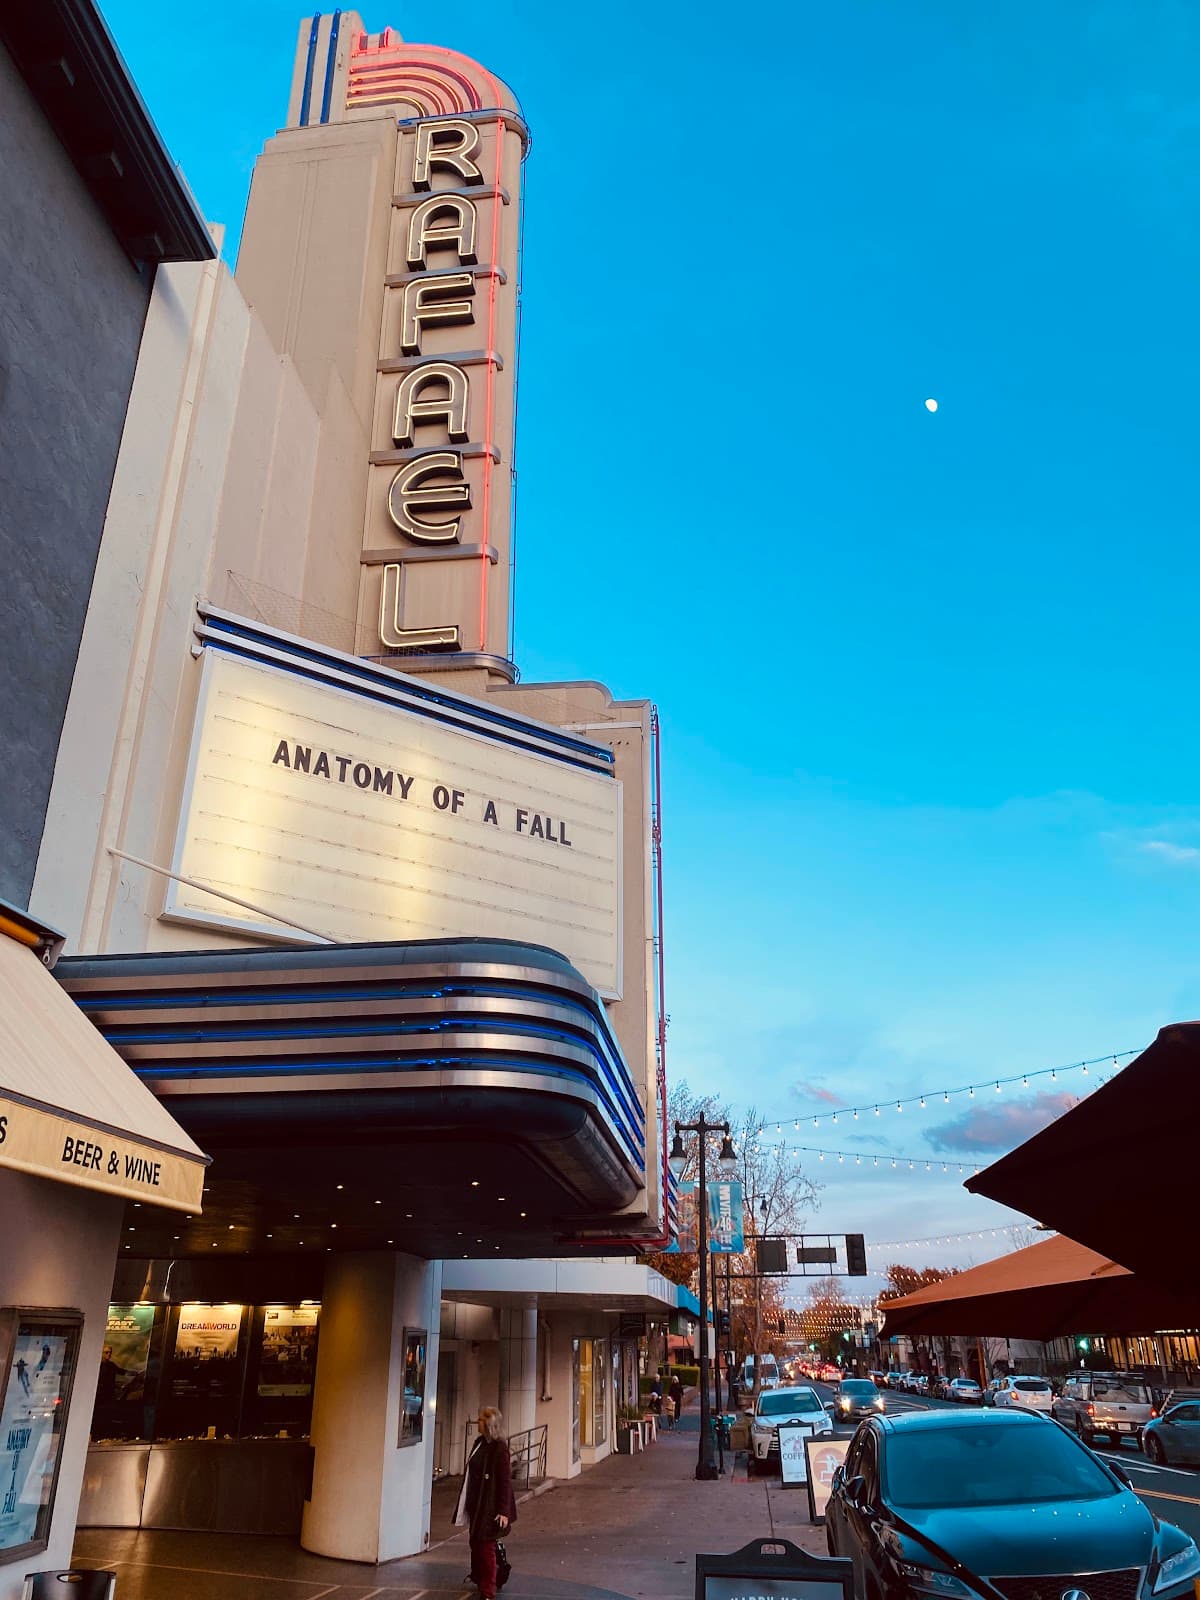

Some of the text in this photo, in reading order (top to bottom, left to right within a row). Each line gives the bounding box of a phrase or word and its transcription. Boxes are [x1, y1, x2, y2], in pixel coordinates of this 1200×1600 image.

[380, 118, 483, 650] RAFAEL
[272, 739, 572, 847] ANATOMY OF A FALL
[61, 1136, 162, 1186] BEER & WINE
[181, 1322, 237, 1330] DREAMWORLD
[782, 1452, 805, 1460] COFF
